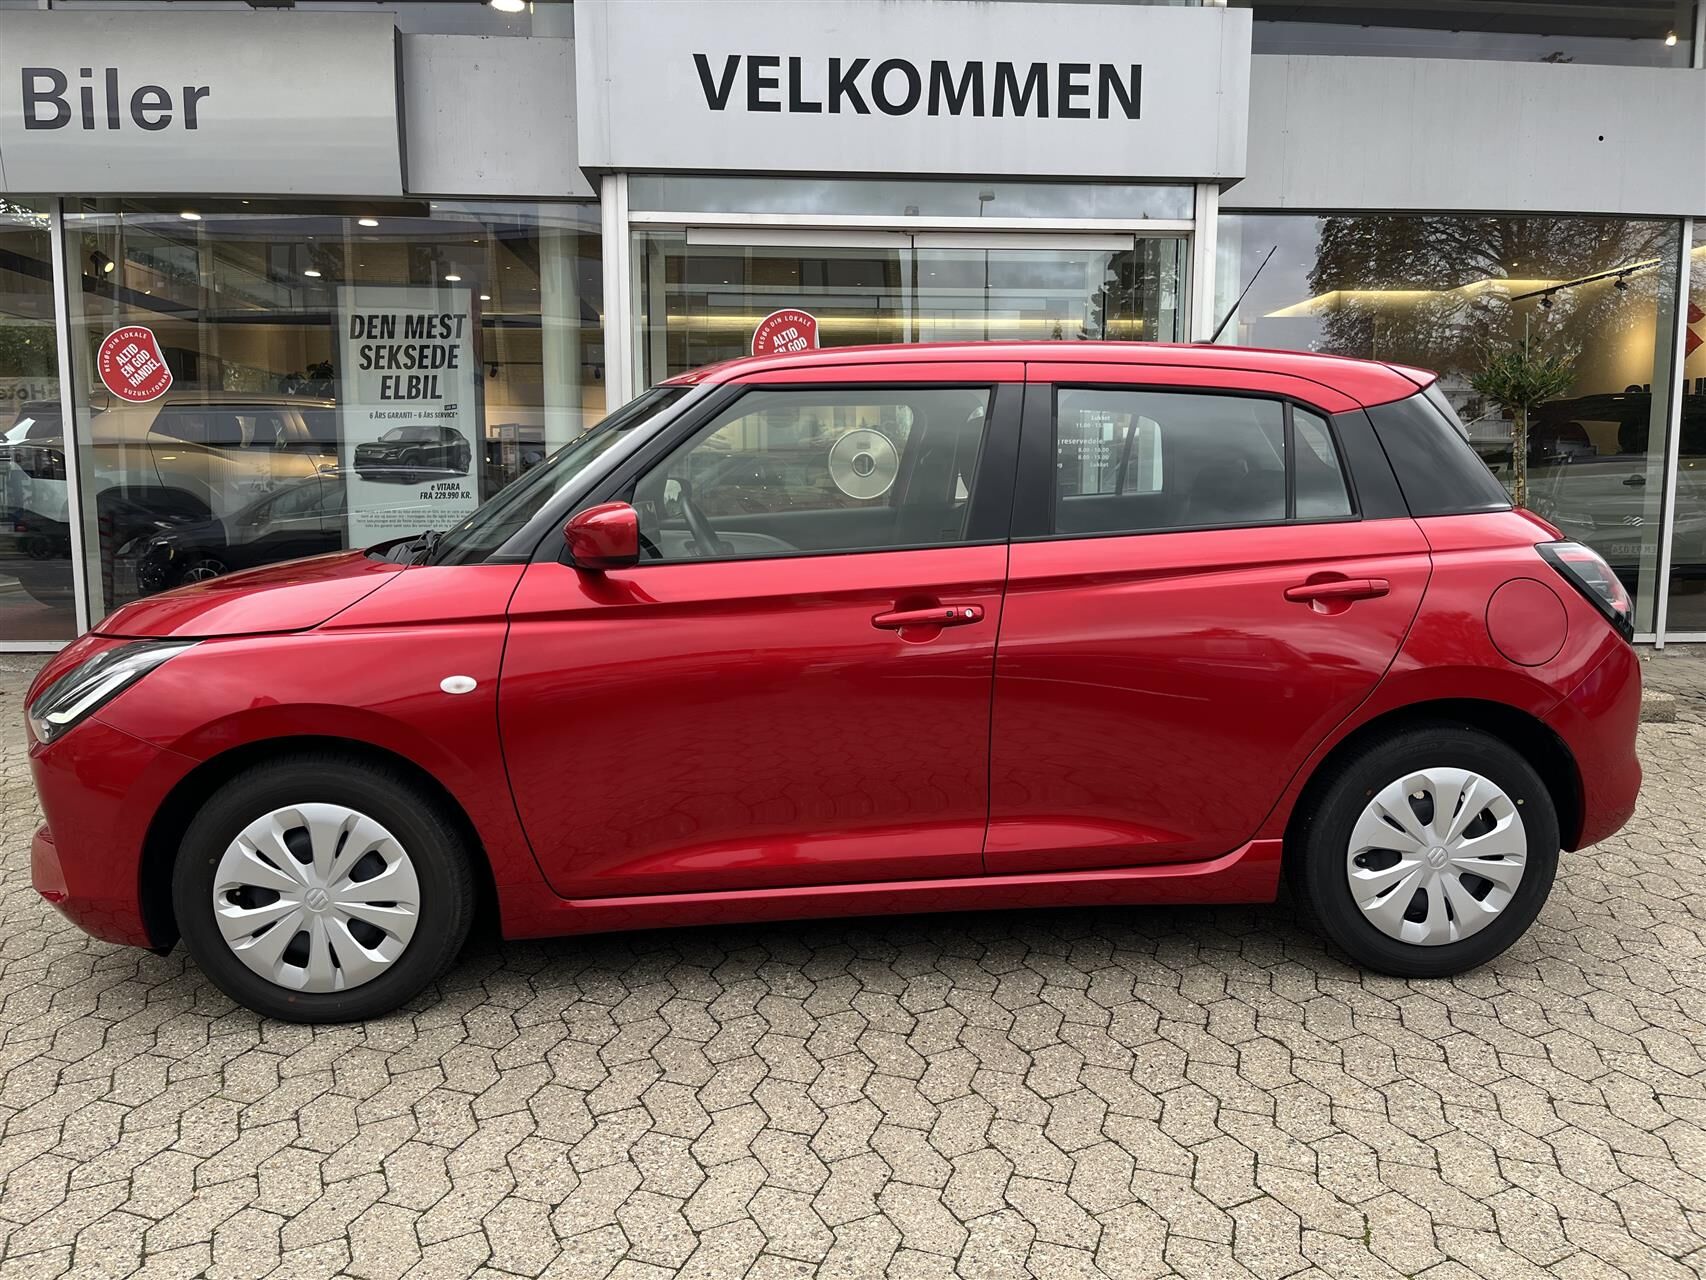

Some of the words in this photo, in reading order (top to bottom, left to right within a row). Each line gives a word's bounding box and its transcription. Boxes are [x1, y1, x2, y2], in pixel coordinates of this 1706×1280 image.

[692, 53, 1142, 120] VELKOMMEN
[21, 67, 210, 131] Biler
[350, 314, 397, 340] DEN
[404, 313, 467, 340] MEST
[769, 317, 782, 327] DIN
[784, 315, 811, 327] LOKALE
[108, 337, 119, 349] DIN
[120, 332, 147, 340] LOKALE
[773, 327, 798, 347] ALTID
[788, 337, 807, 352] GOD
[115, 343, 139, 366] ALTID
[120, 363, 135, 378] EN
[131, 349, 150, 368] GOD
[359, 344, 460, 370] SEKSEDE
[128, 358, 161, 388] HANDEL
[380, 374, 443, 400] ELBIL
[374, 410, 386, 420] ÅRS
[387, 411, 413, 419] GARANTI
[423, 410, 434, 419] ÅRS
[420, 491, 433, 499] FRA
[434, 491, 459, 500] 229.990
[460, 491, 472, 499] KR.
[436, 482, 460, 491] VITARA
